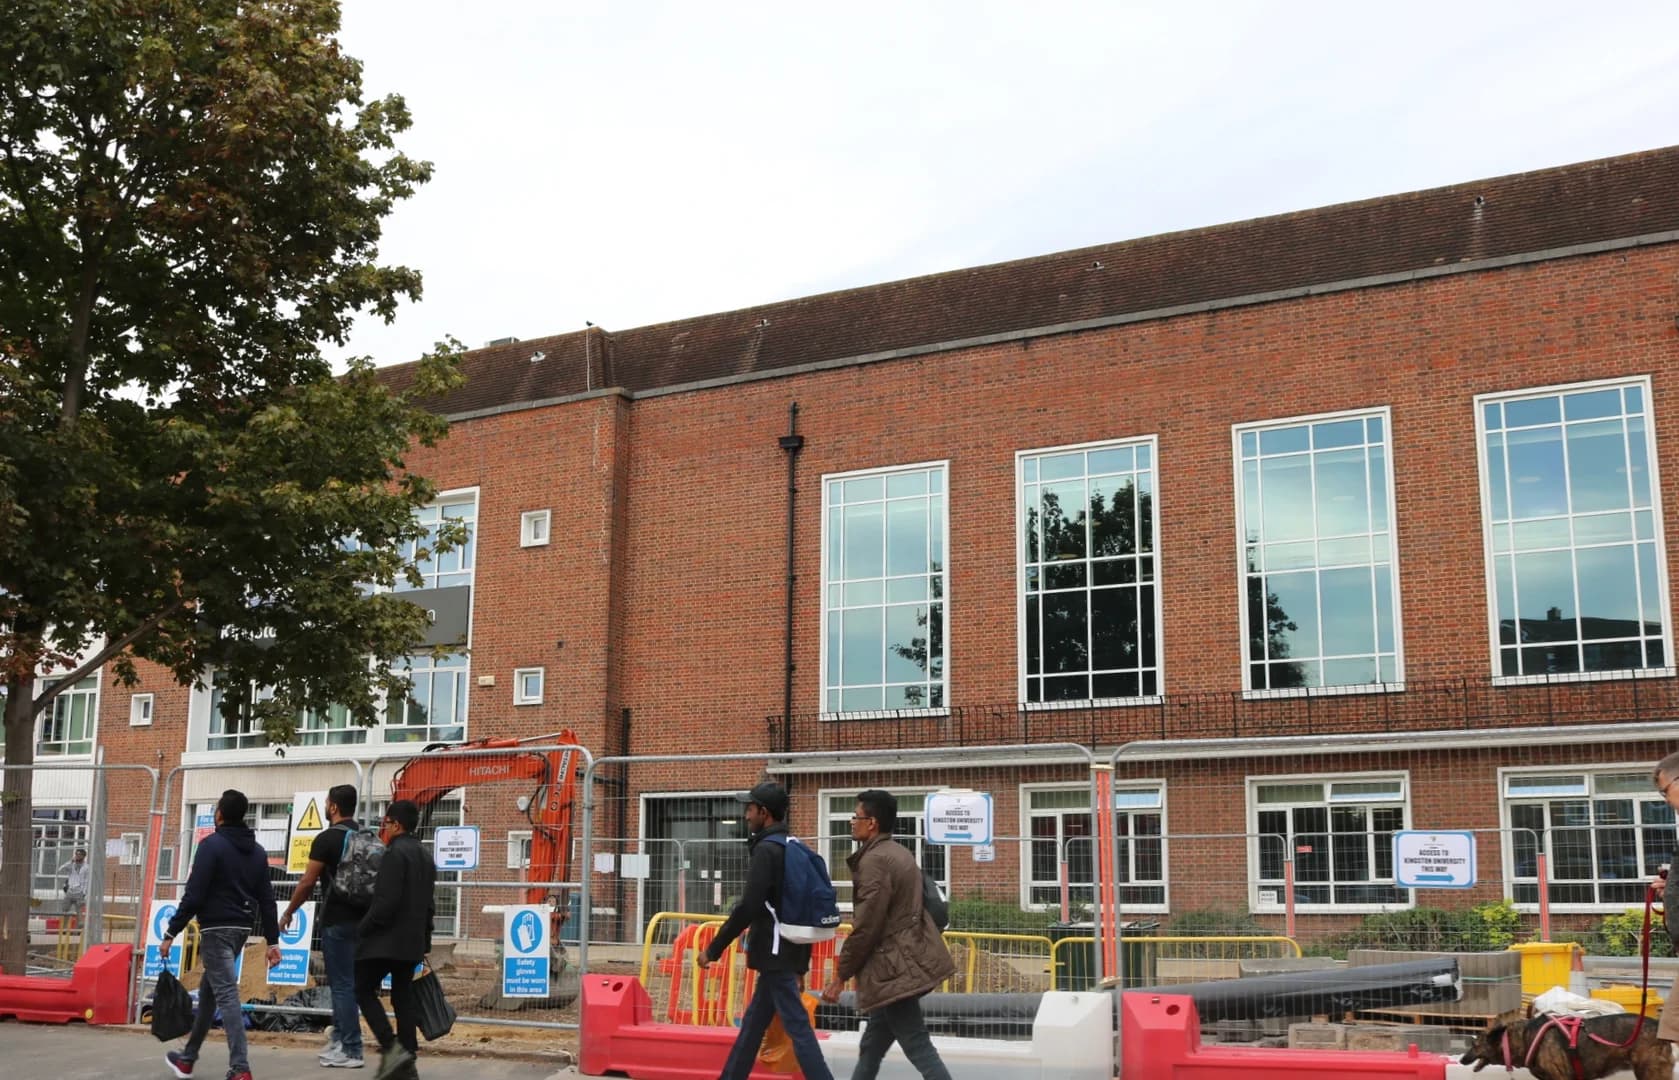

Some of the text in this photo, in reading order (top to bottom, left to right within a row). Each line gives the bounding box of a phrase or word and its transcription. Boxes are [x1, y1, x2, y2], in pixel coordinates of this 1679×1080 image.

[469, 765, 510, 776] HITACHI
[516, 959, 536, 967] Safety
[515, 968, 537, 976] gloves
